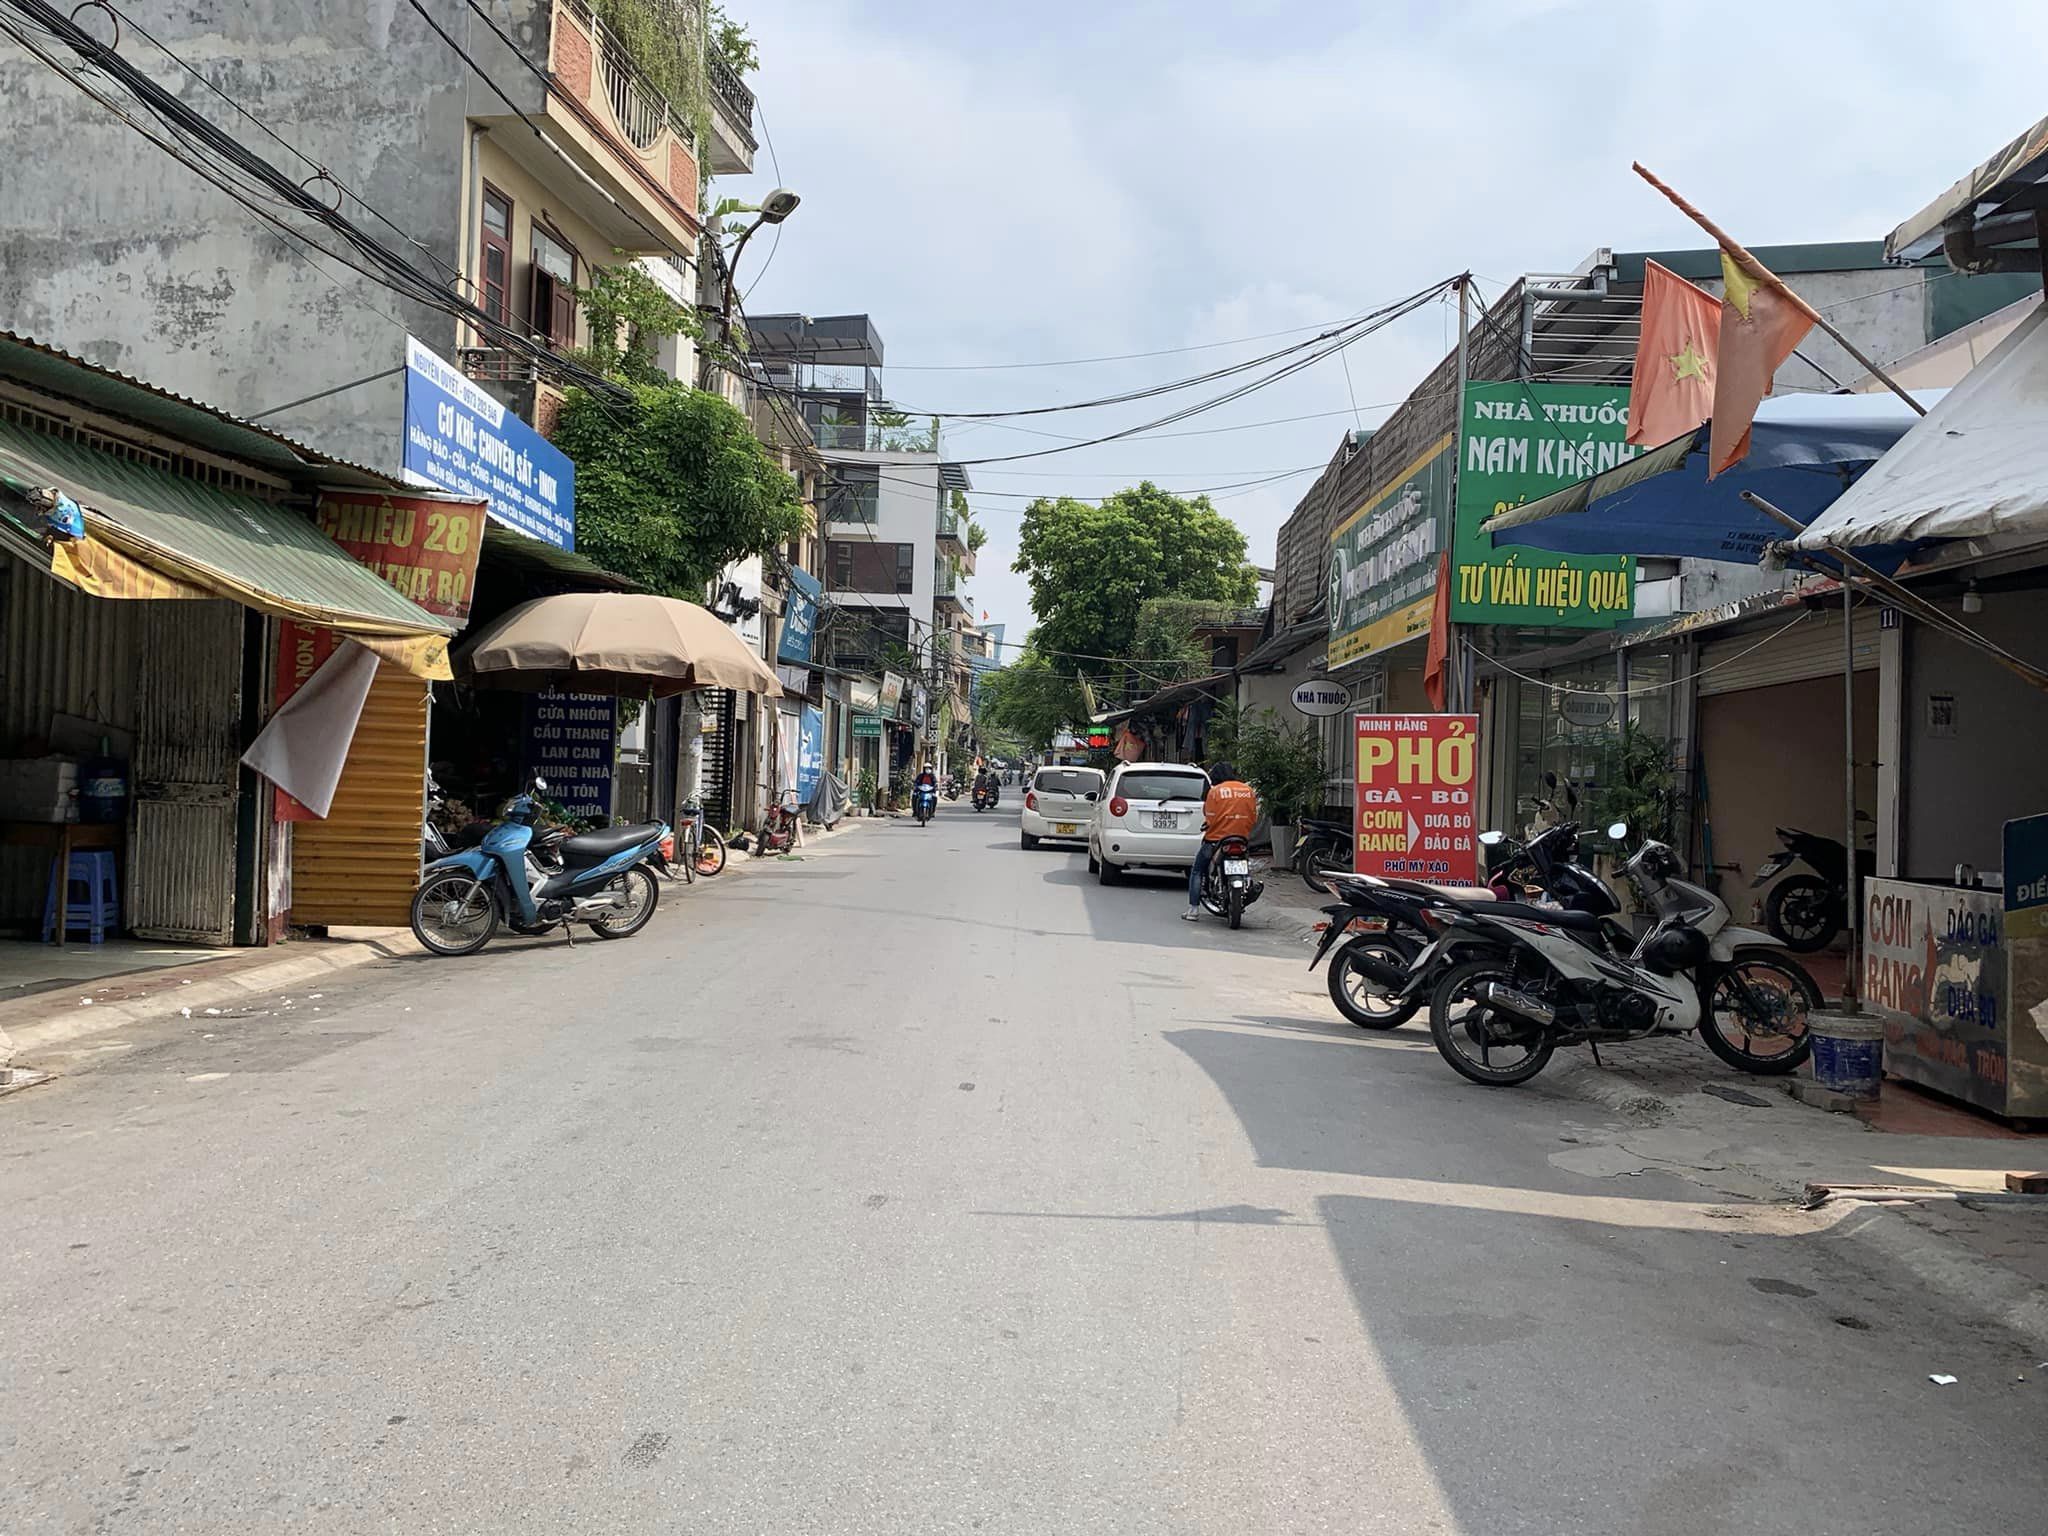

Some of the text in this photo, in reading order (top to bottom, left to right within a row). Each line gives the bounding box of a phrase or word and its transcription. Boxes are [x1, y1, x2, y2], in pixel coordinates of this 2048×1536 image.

[1474, 398, 1629, 425] NHÀ THUỐC
[438, 400, 455, 438] CƠ
[479, 429, 515, 478] CHUYÊN
[516, 448, 533, 488] SẮT
[538, 469, 557, 506] INOX
[1468, 432, 1635, 480] NAM KHÁNH
[423, 512, 471, 555] 28
[436, 567, 467, 606] BÒ
[1460, 561, 1488, 605] TƯ
[1490, 553, 1531, 606] VẤN
[1535, 561, 1582, 617] HIỆU
[1587, 555, 1628, 613] QUẢ
[1317, 690, 1346, 704] THUỐC
[537, 704, 610, 721] CỬA NHÔM
[565, 727, 610, 740] THANG
[1359, 720, 1391, 731] MINH
[541, 746, 600, 759] LAN CAN
[1358, 721, 1475, 785] PHỞ
[581, 764, 610, 779] NHÀ
[541, 783, 599, 797] MÁI TÔN
[1365, 787, 1402, 803] GÀ
[1431, 787, 1469, 804] BÒ
[1363, 809, 1403, 829] CƠM
[1424, 812, 1472, 828] DƯA BÒ
[1358, 833, 1407, 852] RANG
[1424, 832, 1472, 851] ĐẢO GÀ
[1869, 895, 1912, 949] CƠM
[1868, 953, 1922, 1016] RANG
